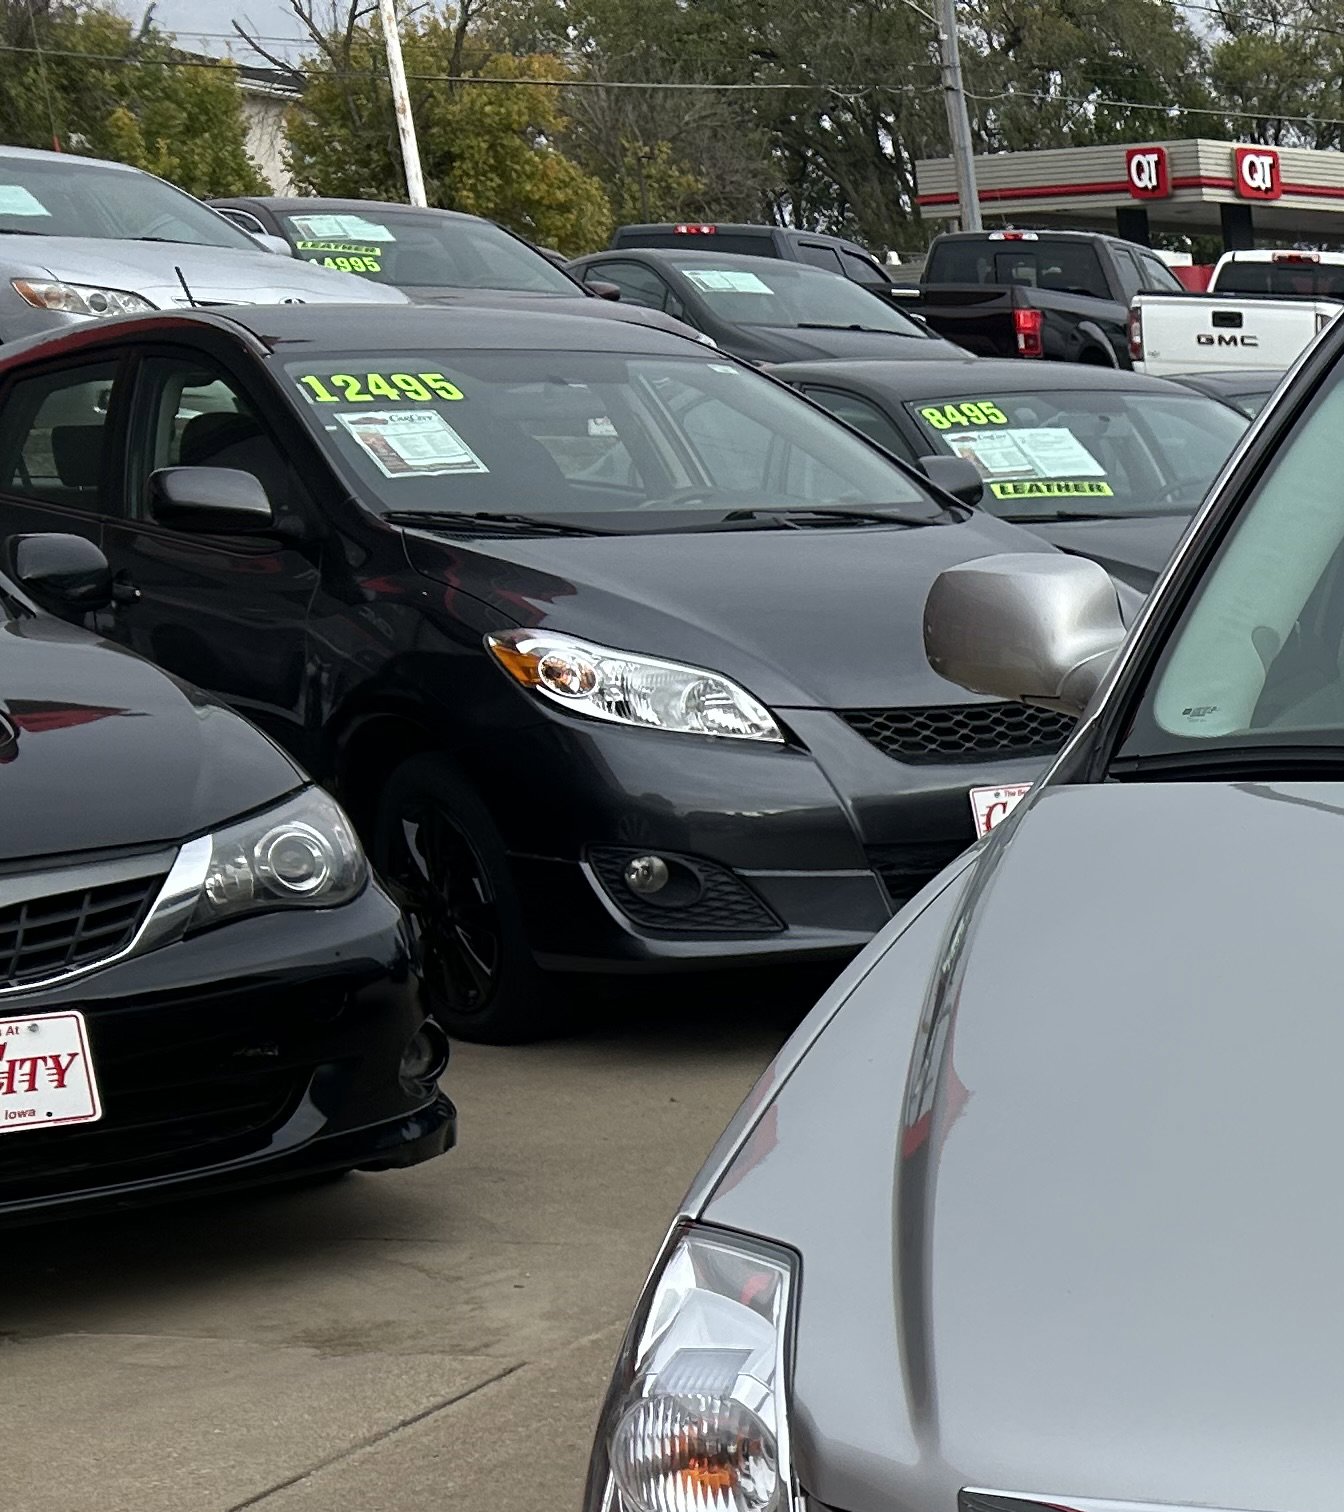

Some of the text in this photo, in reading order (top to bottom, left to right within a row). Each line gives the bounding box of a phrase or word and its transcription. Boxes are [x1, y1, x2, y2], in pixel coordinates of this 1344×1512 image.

[1130, 153, 1159, 189] QT
[1241, 153, 1274, 191] QT
[1196, 334, 1259, 347] GMC
[301, 372, 465, 402] 12495
[921, 401, 1008, 430] 8495
[999, 481, 1106, 496] LEATHER
[5, 1026, 20, 1036] At
[4, 1108, 37, 1120] Iowa
